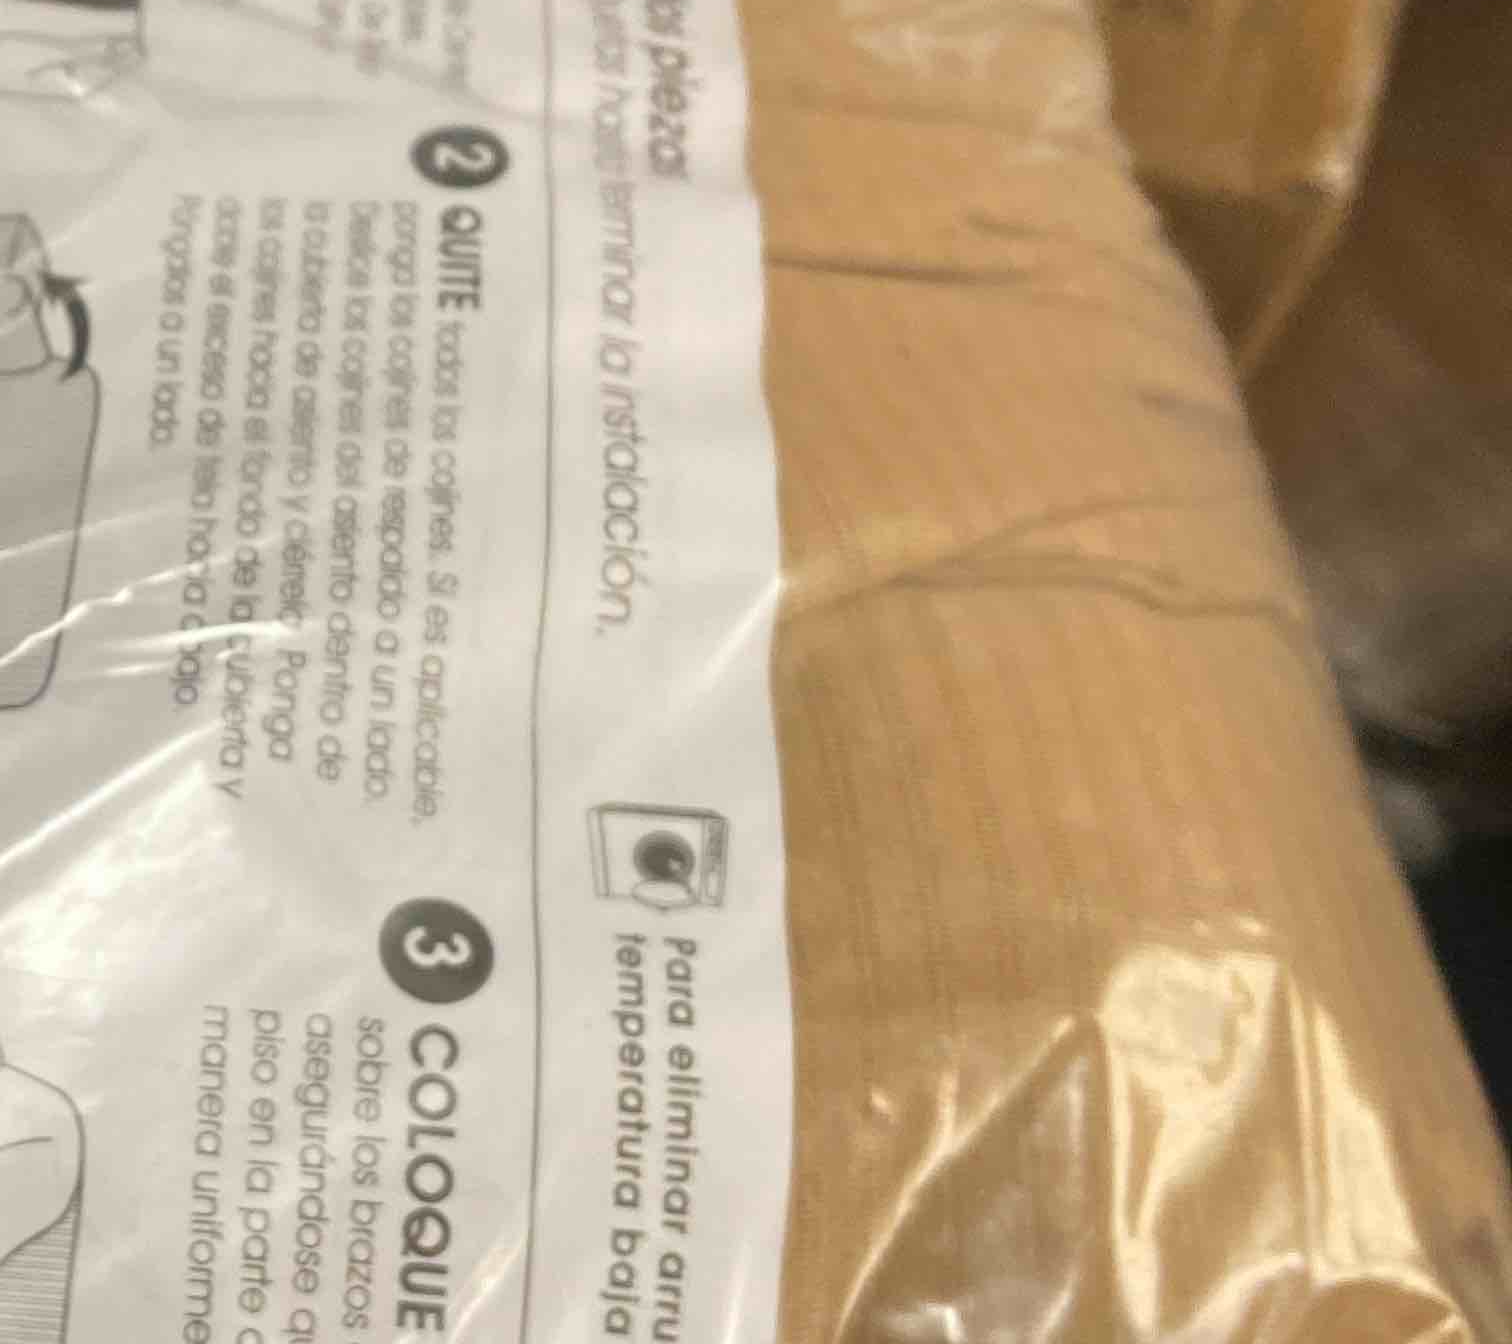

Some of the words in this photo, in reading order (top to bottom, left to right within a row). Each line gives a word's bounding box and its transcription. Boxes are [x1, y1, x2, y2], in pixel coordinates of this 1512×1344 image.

[438, 206, 483, 310] QUITE
[158, 312, 185, 332] a
[155, 339, 182, 375] un
[246, 330, 279, 410] hacia
[295, 340, 324, 377] de
[196, 408, 225, 446] de
[243, 417, 272, 443] el
[384, 437, 413, 477] de
[279, 495, 309, 512] y
[234, 547, 263, 586] de
[328, 495, 361, 603] asiento
[374, 486, 410, 619] respaldo
[229, 596, 260, 622] la
[427, 571, 460, 594] Si
[374, 629, 400, 654] a
[424, 605, 450, 644] es
[320, 612, 358, 725] dentro
[370, 665, 396, 708] un
[264, 650, 307, 761] Ponga
[215, 778, 243, 800] y
[317, 735, 349, 783] de
[364, 720, 398, 803] lado.
[663, 936, 701, 1027] Para
[248, 1008, 284, 1084] piso
[354, 1016, 390, 1122] sobre
[610, 933, 650, 1209] temperatura
[192, 1005, 230, 1156] manera
[246, 1097, 278, 1147] en
[293, 1013, 338, 1293] asegurándose
[661, 1044, 702, 1233] eliminar
[244, 1160, 279, 1193] la
[351, 1136, 387, 1185] los
[396, 1024, 460, 1332] COLOQUE
[237, 1207, 273, 1313] parte
[344, 1201, 385, 1328] brazos
[599, 1229, 643, 1335] baja
